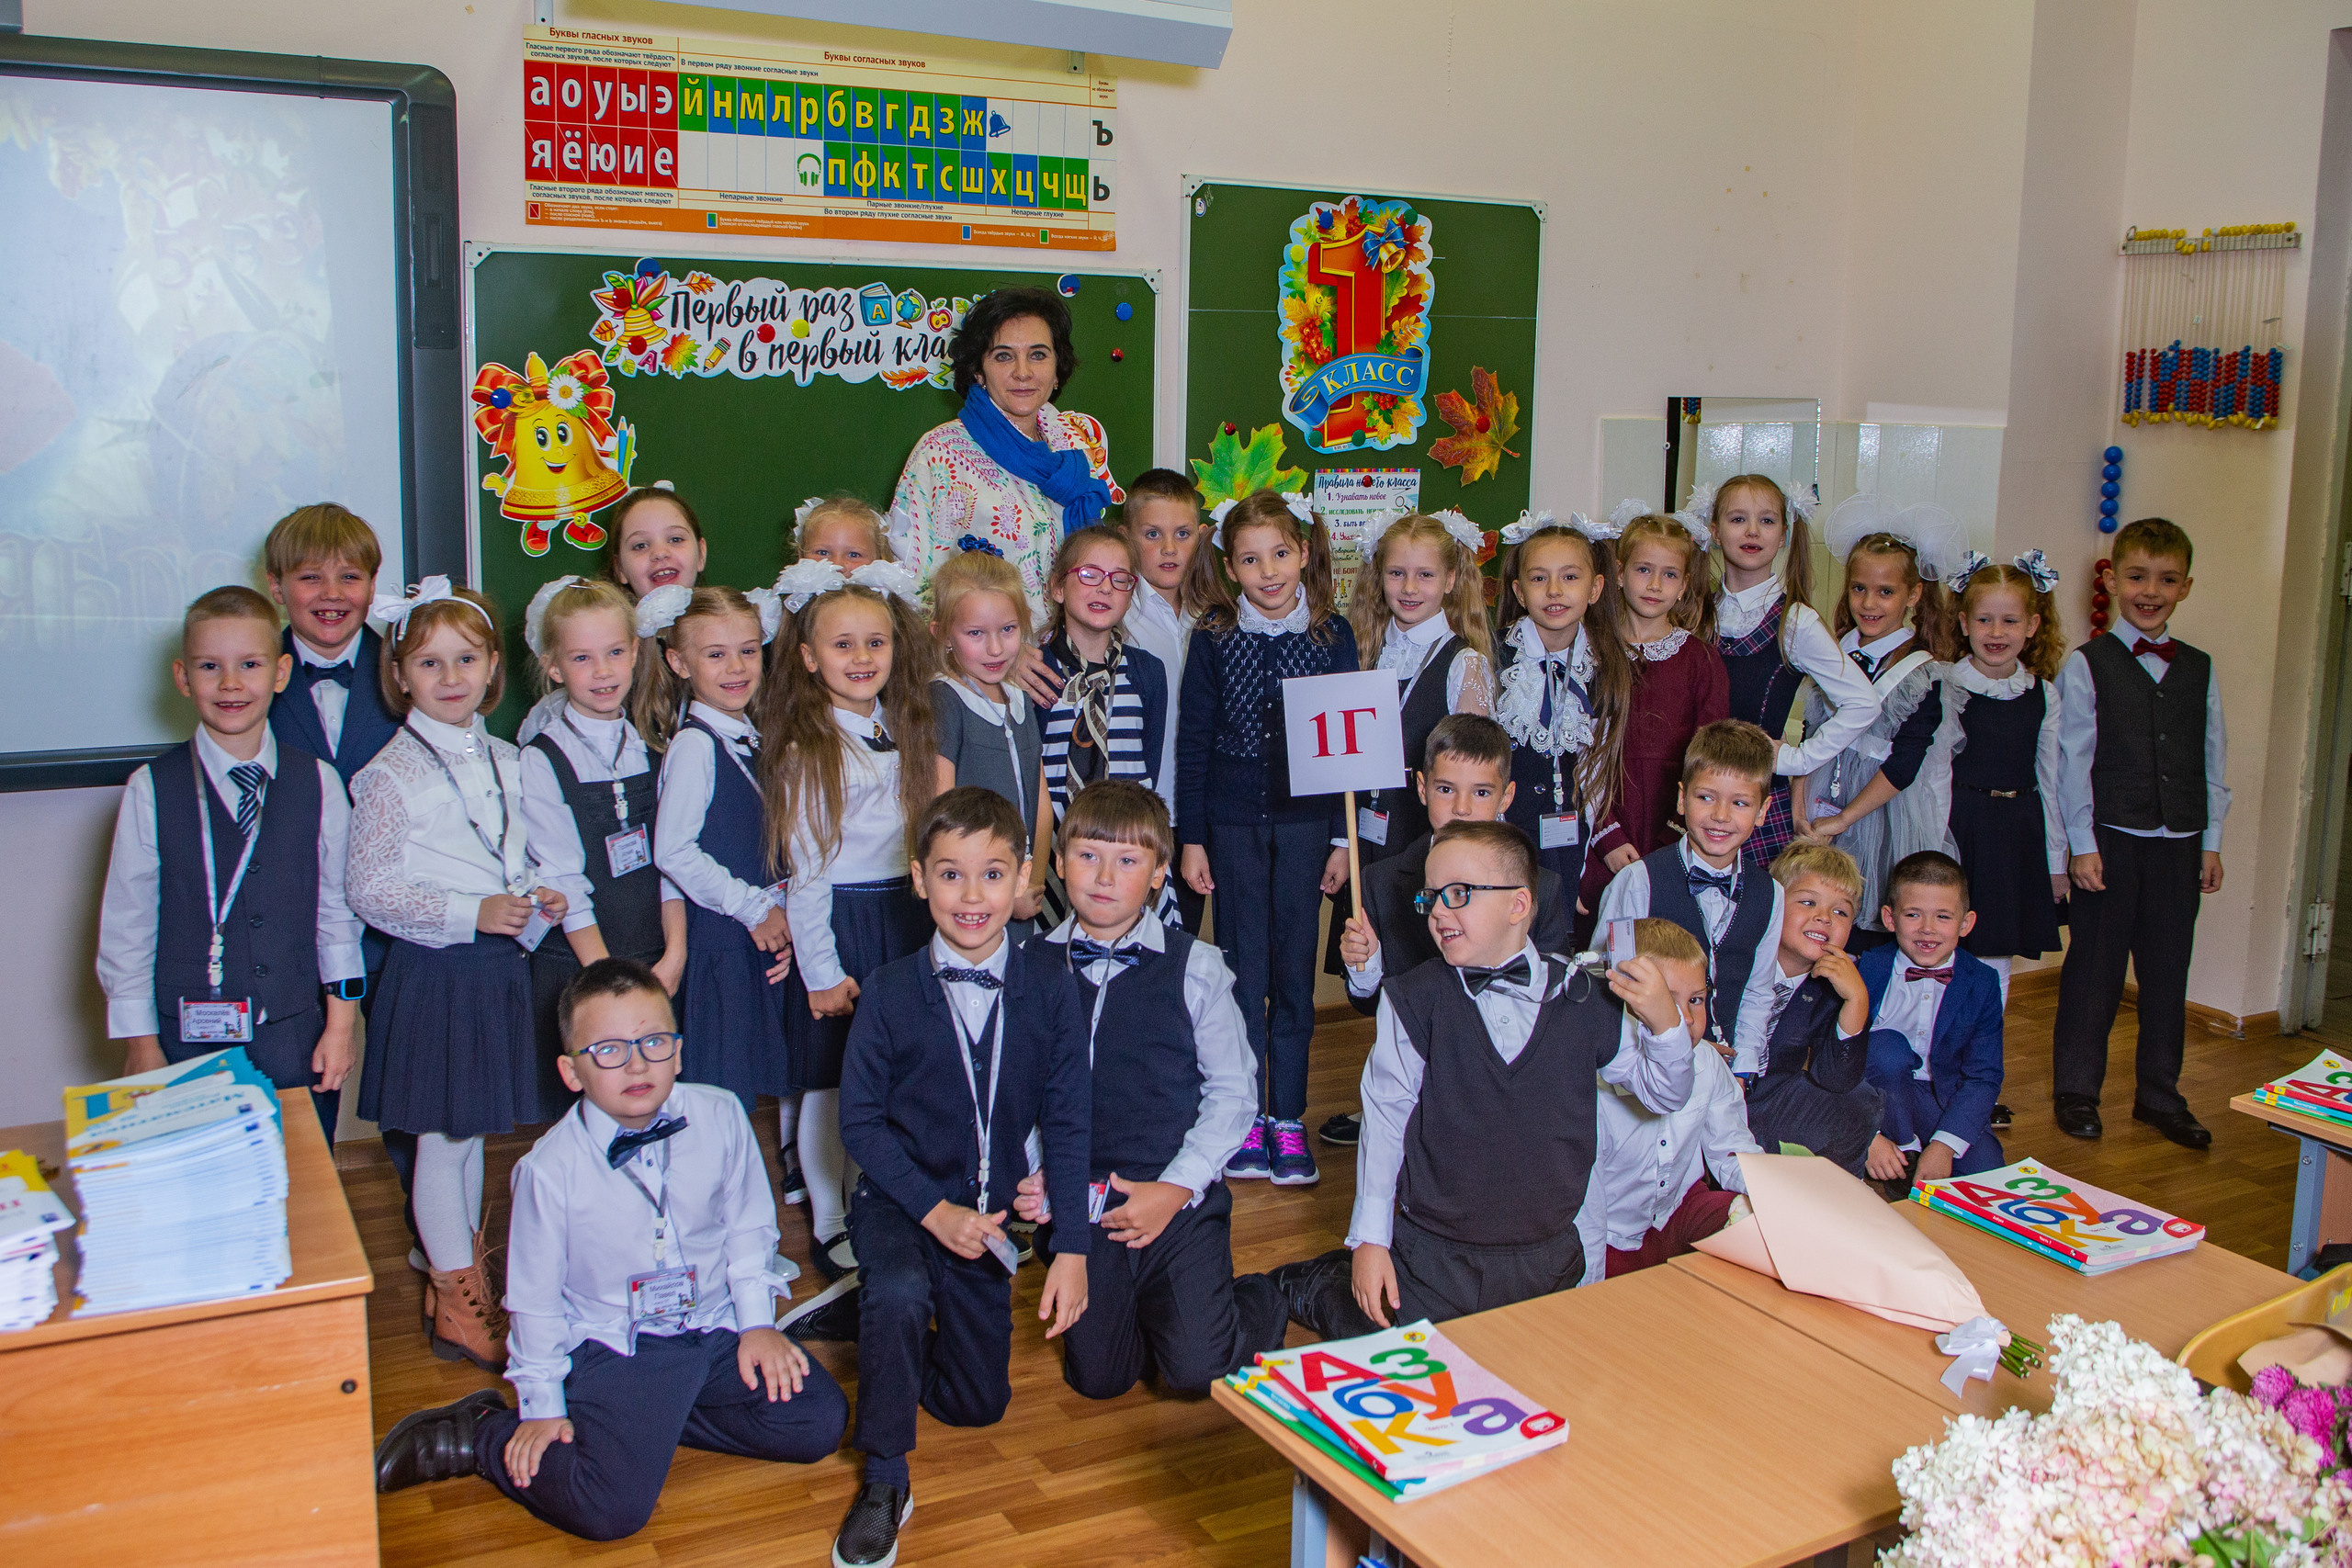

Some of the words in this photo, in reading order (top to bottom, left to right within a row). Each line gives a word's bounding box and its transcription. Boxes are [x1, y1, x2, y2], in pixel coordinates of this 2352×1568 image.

[549, 28, 579, 39] Буквы
[582, 32, 619, 42] гласных
[622, 36, 653, 45] звуков
[526, 42, 553, 51] Гласные
[556, 46, 582, 54] первого
[584, 48, 600, 56] ряда
[602, 50, 640, 58] обозначают
[643, 53, 675, 62] твёрдость
[530, 51, 565, 60] согласных
[567, 54, 591, 62] звуков,
[615, 58, 641, 66] которых
[824, 51, 851, 62] Буквы
[853, 55, 896, 65] согласных
[899, 59, 926, 68] звуков
[716, 62, 732, 71] ряду
[734, 64, 762, 73] звонкие
[763, 67, 798, 75] согласные
[529, 184, 558, 192] Гласные
[559, 186, 585, 194] второго
[605, 188, 643, 197] обозначают
[719, 192, 754, 201] Непарные
[644, 197, 672, 206] следуют
[867, 200, 892, 209] Парные
[894, 202, 944, 211] звонкие/глухие
[834, 209, 859, 217] втором
[900, 212, 933, 220] согласные
[1011, 209, 1042, 218] Непарные
[671, 283, 791, 342] Первый
[798, 292, 854, 336] раз
[1307, 224, 1386, 448] 1
[738, 329, 759, 373] в
[768, 326, 885, 382] первый
[892, 333, 949, 366] кла
[1320, 361, 1415, 396] КЛАСС
[1318, 475, 1354, 493] Правила
[1387, 477, 1418, 489] класса
[1335, 492, 1368, 503] Узнавать
[1369, 491, 1387, 501] новое
[1308, 707, 1377, 758] 1Г
